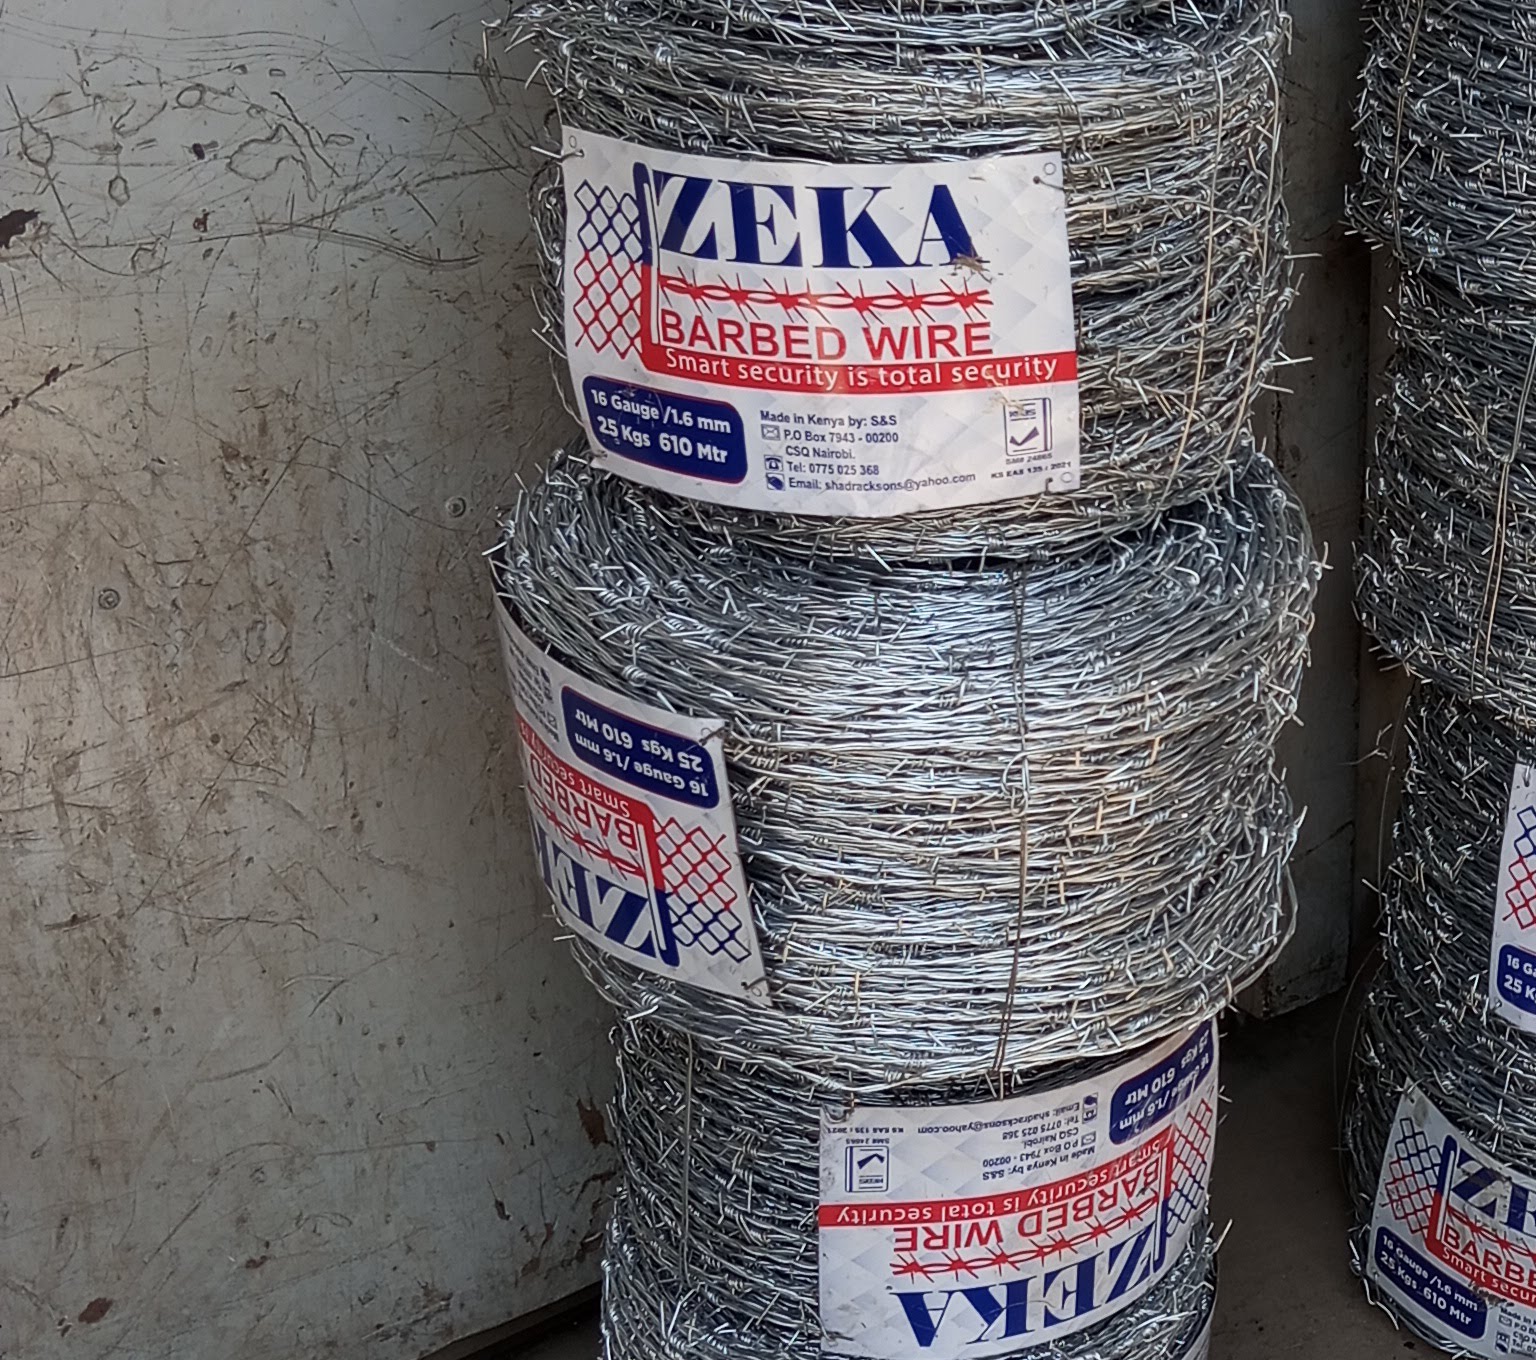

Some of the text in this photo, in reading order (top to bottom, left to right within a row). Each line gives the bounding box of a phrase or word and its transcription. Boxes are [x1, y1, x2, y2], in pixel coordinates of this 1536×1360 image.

[649, 169, 990, 269] ZEKA
[659, 309, 994, 361] BARBED WIRE
[665, 348, 1058, 392] Smart security is total security
[590, 388, 732, 434] 16 Gauge /1.6 mm
[760, 410, 790, 424] Made
[807, 414, 845, 429] Kenya
[848, 416, 868, 429] by:
[871, 415, 897, 426] S&S
[598, 415, 728, 465] 25 Kgs 610 Mtr
[784, 429, 801, 441] P.O
[805, 431, 826, 443] Box
[829, 432, 855, 443] 7943
[865, 432, 899, 443] 00200
[785, 446, 810, 458] CSQ
[787, 461, 879, 475] Tel: 0775 025 368
[789, 472, 976, 492] Email: shadracksons@yahoo.com
[603, 724, 704, 772] 25 Kgs 610
[1507, 954, 1520, 970] 16
[1504, 975, 1521, 993] 25
[1125, 1068, 1175, 1105] 610 Mtr
[836, 1140, 1160, 1225] Smart security is total security
[892, 1157, 1160, 1254] BARBED WIRE
[889, 1221, 1156, 1348] ZEKA
[1443, 1247, 1486, 1283] Smart
